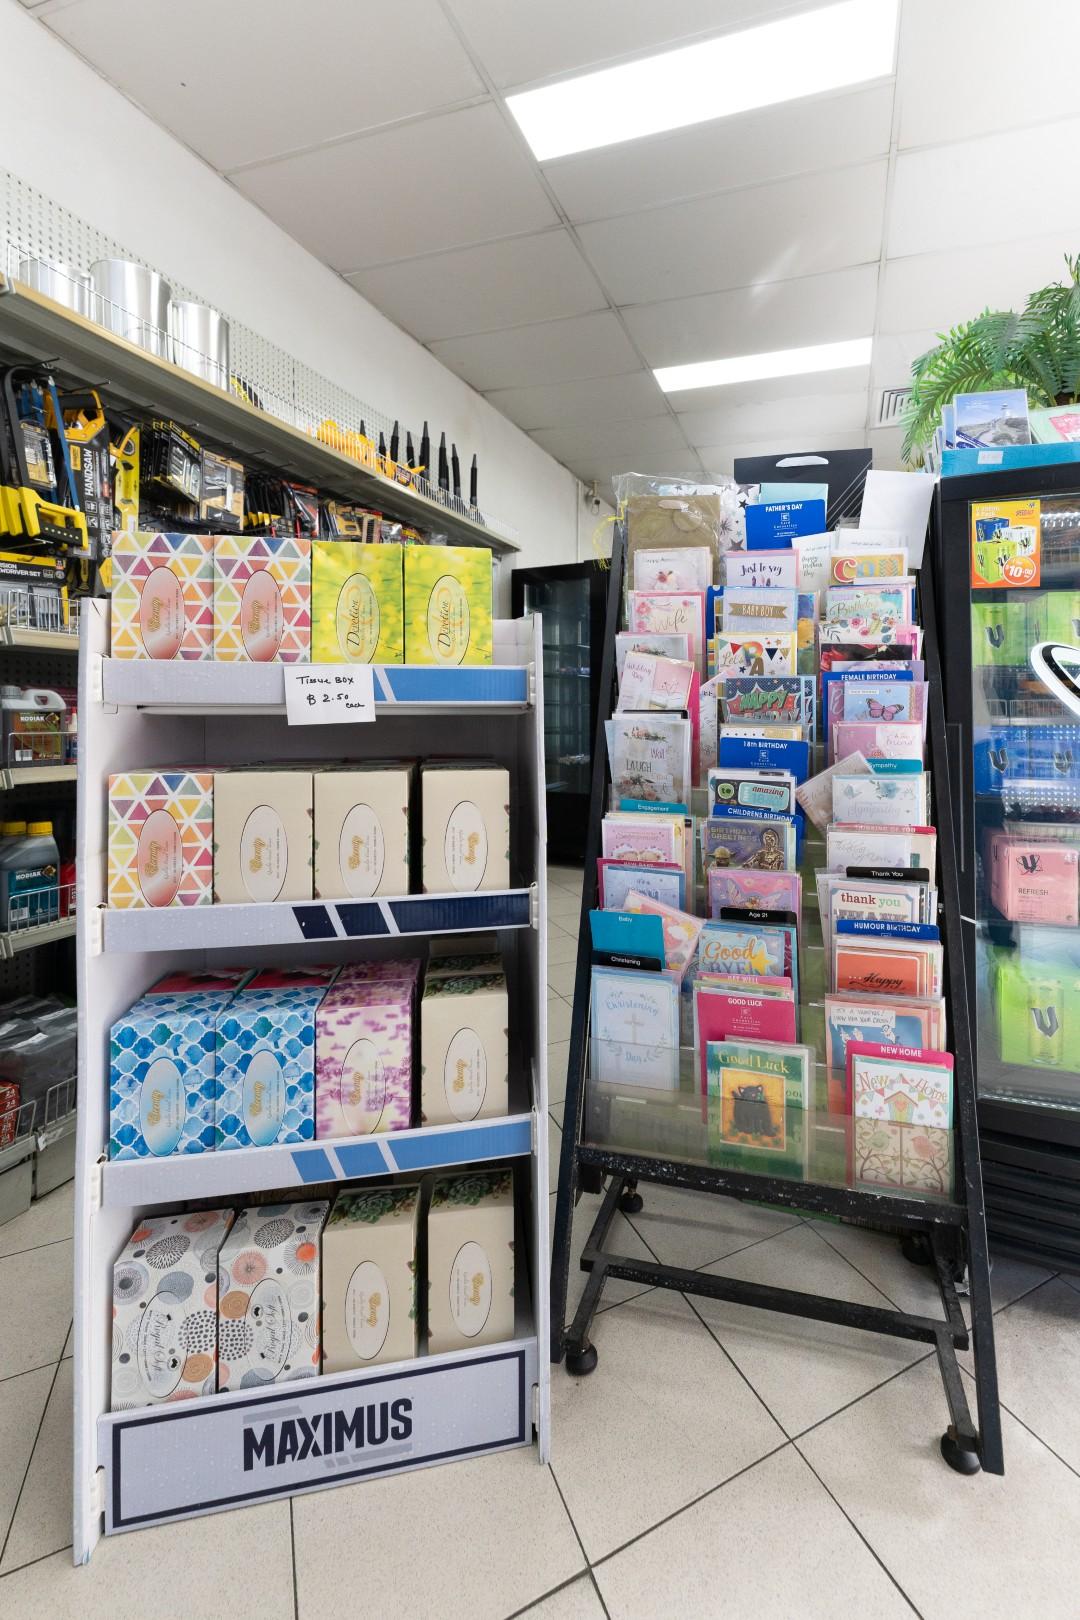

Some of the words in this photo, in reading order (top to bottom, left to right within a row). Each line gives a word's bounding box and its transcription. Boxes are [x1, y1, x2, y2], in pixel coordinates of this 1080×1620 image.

[83, 448, 93, 497] HANDSAW
[765, 504, 791, 513] FATHER'S
[740, 562, 756, 577] Just
[760, 562, 766, 572] to
[768, 565, 782, 576] say
[741, 605, 759, 617] BABY
[760, 606, 774, 617] BOY
[655, 608, 689, 632] Wife
[295, 675, 332, 685] Tissue
[322, 693, 349, 703] 2.50
[740, 690, 788, 711] HAPPY
[743, 740, 758, 748] 18th
[758, 741, 788, 750] BIRTHDAY
[626, 759, 652, 773] LAUGH
[720, 787, 732, 795] to
[751, 786, 785, 798] amazing
[637, 803, 669, 811] Engagement
[727, 807, 763, 819] CHILDRENS
[763, 811, 794, 822] BIRTHDAY
[711, 826, 753, 835] BIRTHDAY
[1017, 887, 1049, 897] REFRESH
[841, 892, 877, 905] thank
[878, 898, 901, 908] you
[853, 922, 885, 930] HUMOUR
[886, 924, 921, 933] BIRTHDAY
[701, 938, 757, 962] Good
[610, 955, 641, 966] Christening
[727, 997, 747, 1006] GOOD
[747, 998, 763, 1007] LUCK
[880, 1045, 898, 1054] NEW
[899, 1047, 923, 1058] HOME
[718, 1049, 753, 1067] Good
[755, 1055, 790, 1074] Luck
[857, 1071, 889, 1092] New
[914, 1078, 948, 1102] Home
[243, 1397, 413, 1473] MAXIMUS
